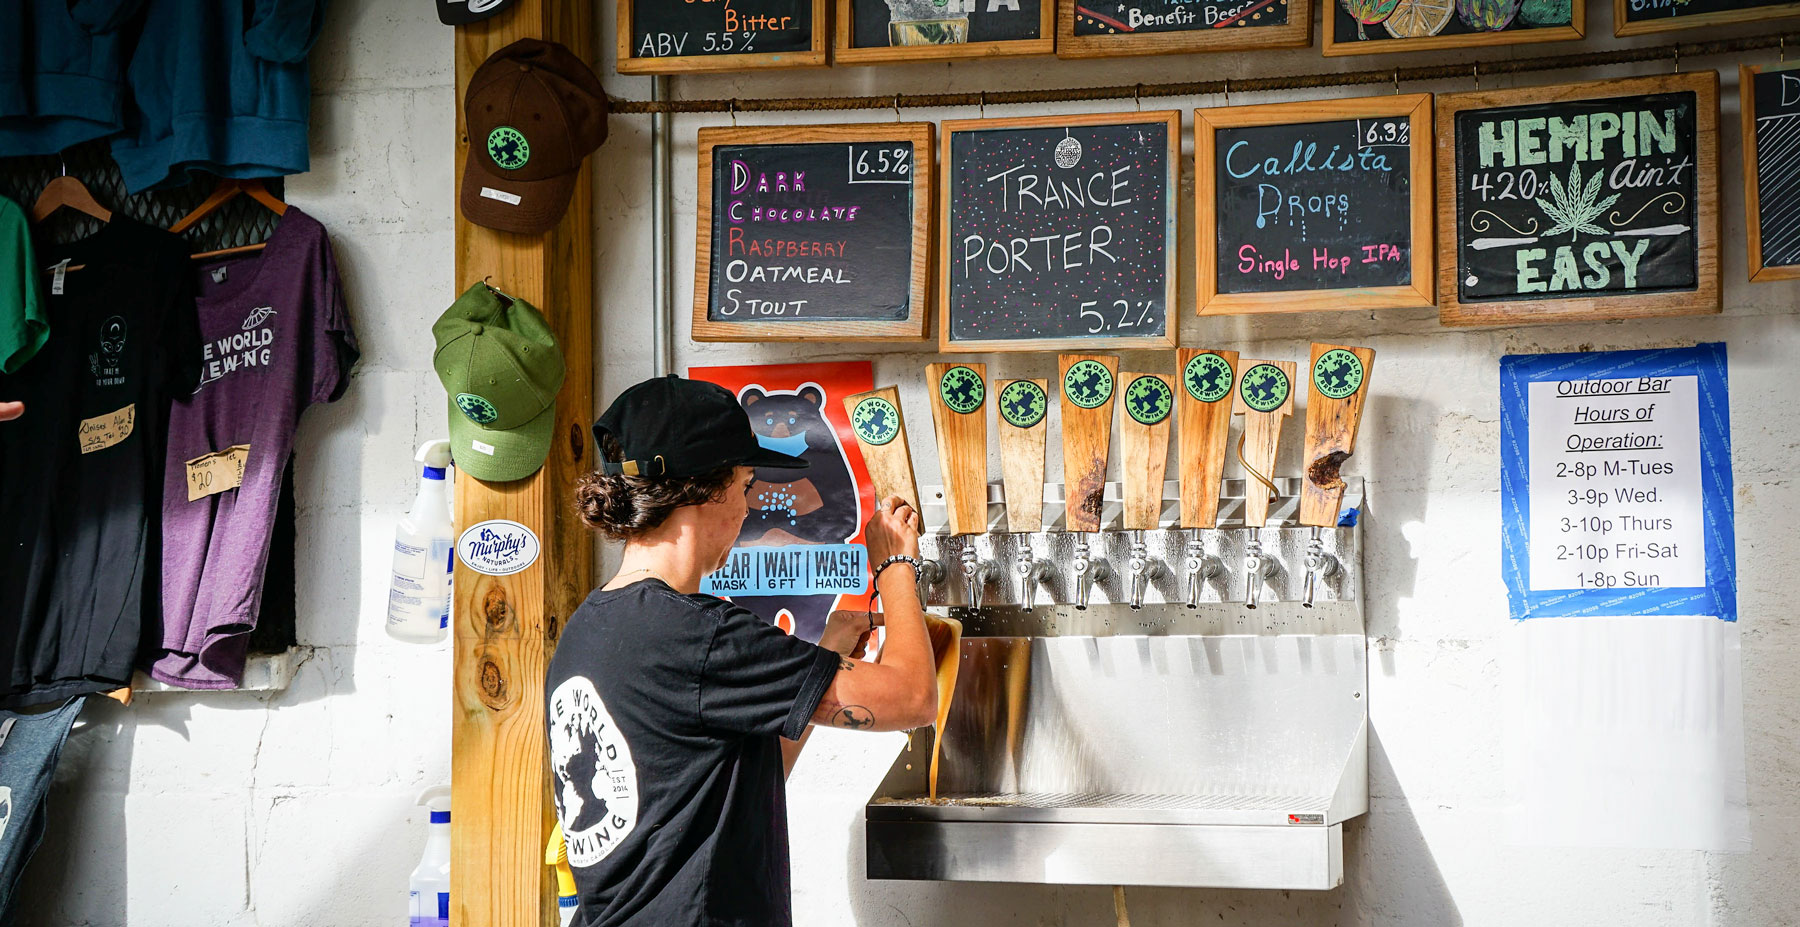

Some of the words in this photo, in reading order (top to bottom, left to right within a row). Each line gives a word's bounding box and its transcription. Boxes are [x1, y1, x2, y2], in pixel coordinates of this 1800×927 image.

[725, 9, 791, 32] Bitter
[1128, 6, 1196, 28] Benefit
[1204, 5, 1243, 25] Beer
[639, 33, 688, 57] ABV
[489, 131, 501, 145] ONE
[504, 130, 528, 151] WORLD
[1366, 122, 1409, 143] 6.3%
[1479, 109, 1677, 169] HEMPIN
[856, 149, 909, 175] 6.5%
[1226, 140, 1392, 178] Callista
[987, 164, 1132, 212] TRANCE
[1471, 169, 1549, 201] 4.20%
[728, 200, 861, 224] CHOCOLATE
[729, 227, 847, 257] RASPBERRY
[964, 225, 1116, 278] PORTER
[726, 259, 852, 283] OATMEAL
[1238, 244, 1300, 280] Single
[1313, 248, 1351, 274] Hop
[1362, 243, 1400, 263] IPA
[1516, 239, 1650, 293] EASY
[721, 289, 808, 316] STOUT
[1080, 300, 1154, 333] 5.2%
[217, 328, 273, 355] WORLD
[1067, 366, 1081, 381] ONE
[1084, 363, 1110, 384] WORLD
[1187, 359, 1202, 374] ONE
[1205, 357, 1231, 378] WORLD
[1317, 355, 1333, 370] ONE
[1336, 353, 1361, 375] WORLD
[943, 373, 955, 388] ONE
[957, 370, 982, 389] WORLD
[1243, 369, 1258, 384] ONE
[1262, 367, 1286, 387] WORLD
[1320, 380, 1353, 394] BREWING
[1557, 377, 1632, 395] Outdoor
[1638, 376, 1671, 391] Bar
[1002, 386, 1015, 402] ONE
[1018, 383, 1044, 401] WORLD
[1071, 390, 1104, 403] BREWING
[1128, 381, 1143, 396] ONE
[1146, 378, 1170, 400] WORLD
[1191, 384, 1224, 397] BREWING
[1247, 393, 1280, 406] BREWING
[855, 406, 866, 423] ONE
[867, 401, 895, 417] WORLD
[1007, 411, 1039, 422] BREWING
[1132, 406, 1164, 419] BREWING
[1574, 406, 1629, 422] Hours
[1636, 403, 1656, 420] of
[863, 427, 893, 440] BREWING
[1567, 432, 1663, 453] Operation:
[1556, 461, 1597, 480] 2-8p
[1604, 459, 1674, 476] M-Tues
[192, 471, 212, 490] $20
[1568, 489, 1608, 508] 3-9p
[1614, 487, 1663, 504] Wed.
[1560, 516, 1612, 535] 3-10p
[1619, 515, 1672, 531] Thurs
[469, 533, 526, 560] Murphy's
[1556, 544, 1609, 563] 2-10p
[1616, 543, 1679, 559] Fri-Sat
[482, 556, 513, 566] NATURALS
[764, 552, 801, 578] WAIT
[815, 551, 860, 577] WASH
[712, 580, 747, 590] MASK
[768, 579, 776, 589] 6
[780, 579, 796, 589] FT
[816, 578, 860, 588] HANDS
[1577, 572, 1616, 588] 1-8p
[1623, 571, 1660, 587] Sun
[572, 689, 617, 761] WORLD
[613, 785, 629, 793] 2014
